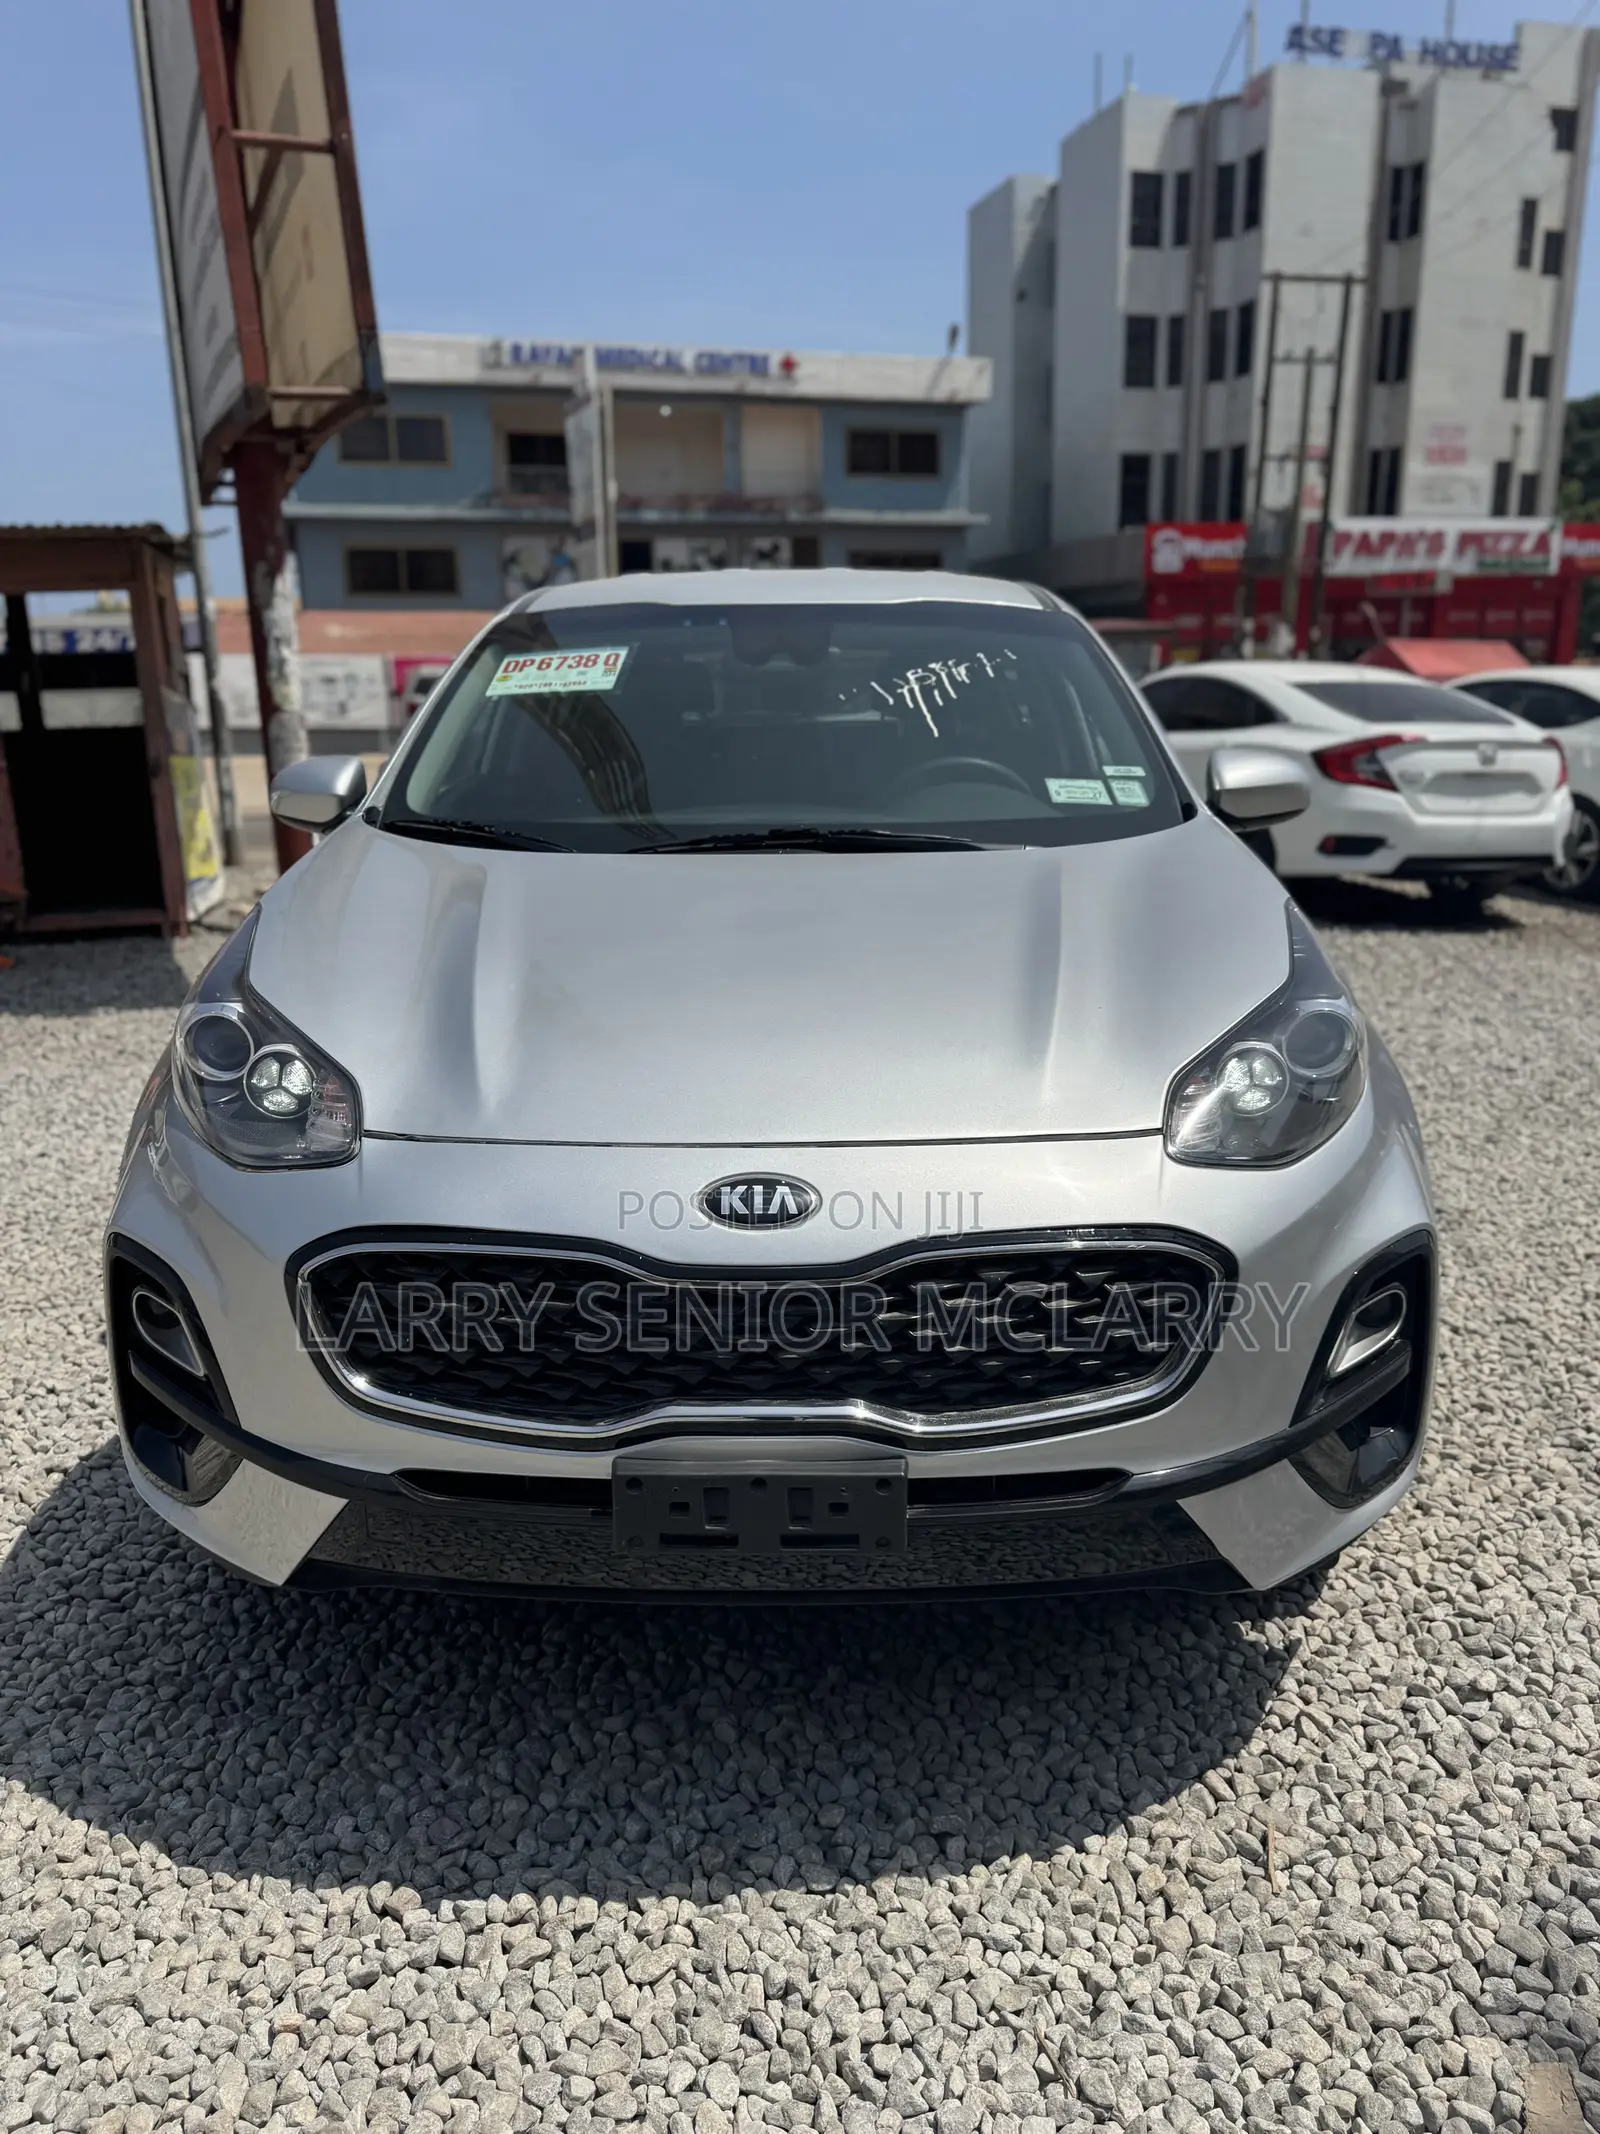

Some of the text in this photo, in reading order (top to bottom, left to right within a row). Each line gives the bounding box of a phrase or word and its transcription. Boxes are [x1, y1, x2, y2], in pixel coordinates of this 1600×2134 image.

[1285, 25, 1519, 71] ASE PA HOUSE
[595, 347, 690, 373] MEDICAL
[695, 352, 770, 377] CENTRE
[1332, 530, 1551, 562] PAPA'S PIZZA
[719, 1184, 799, 1215] KIA
